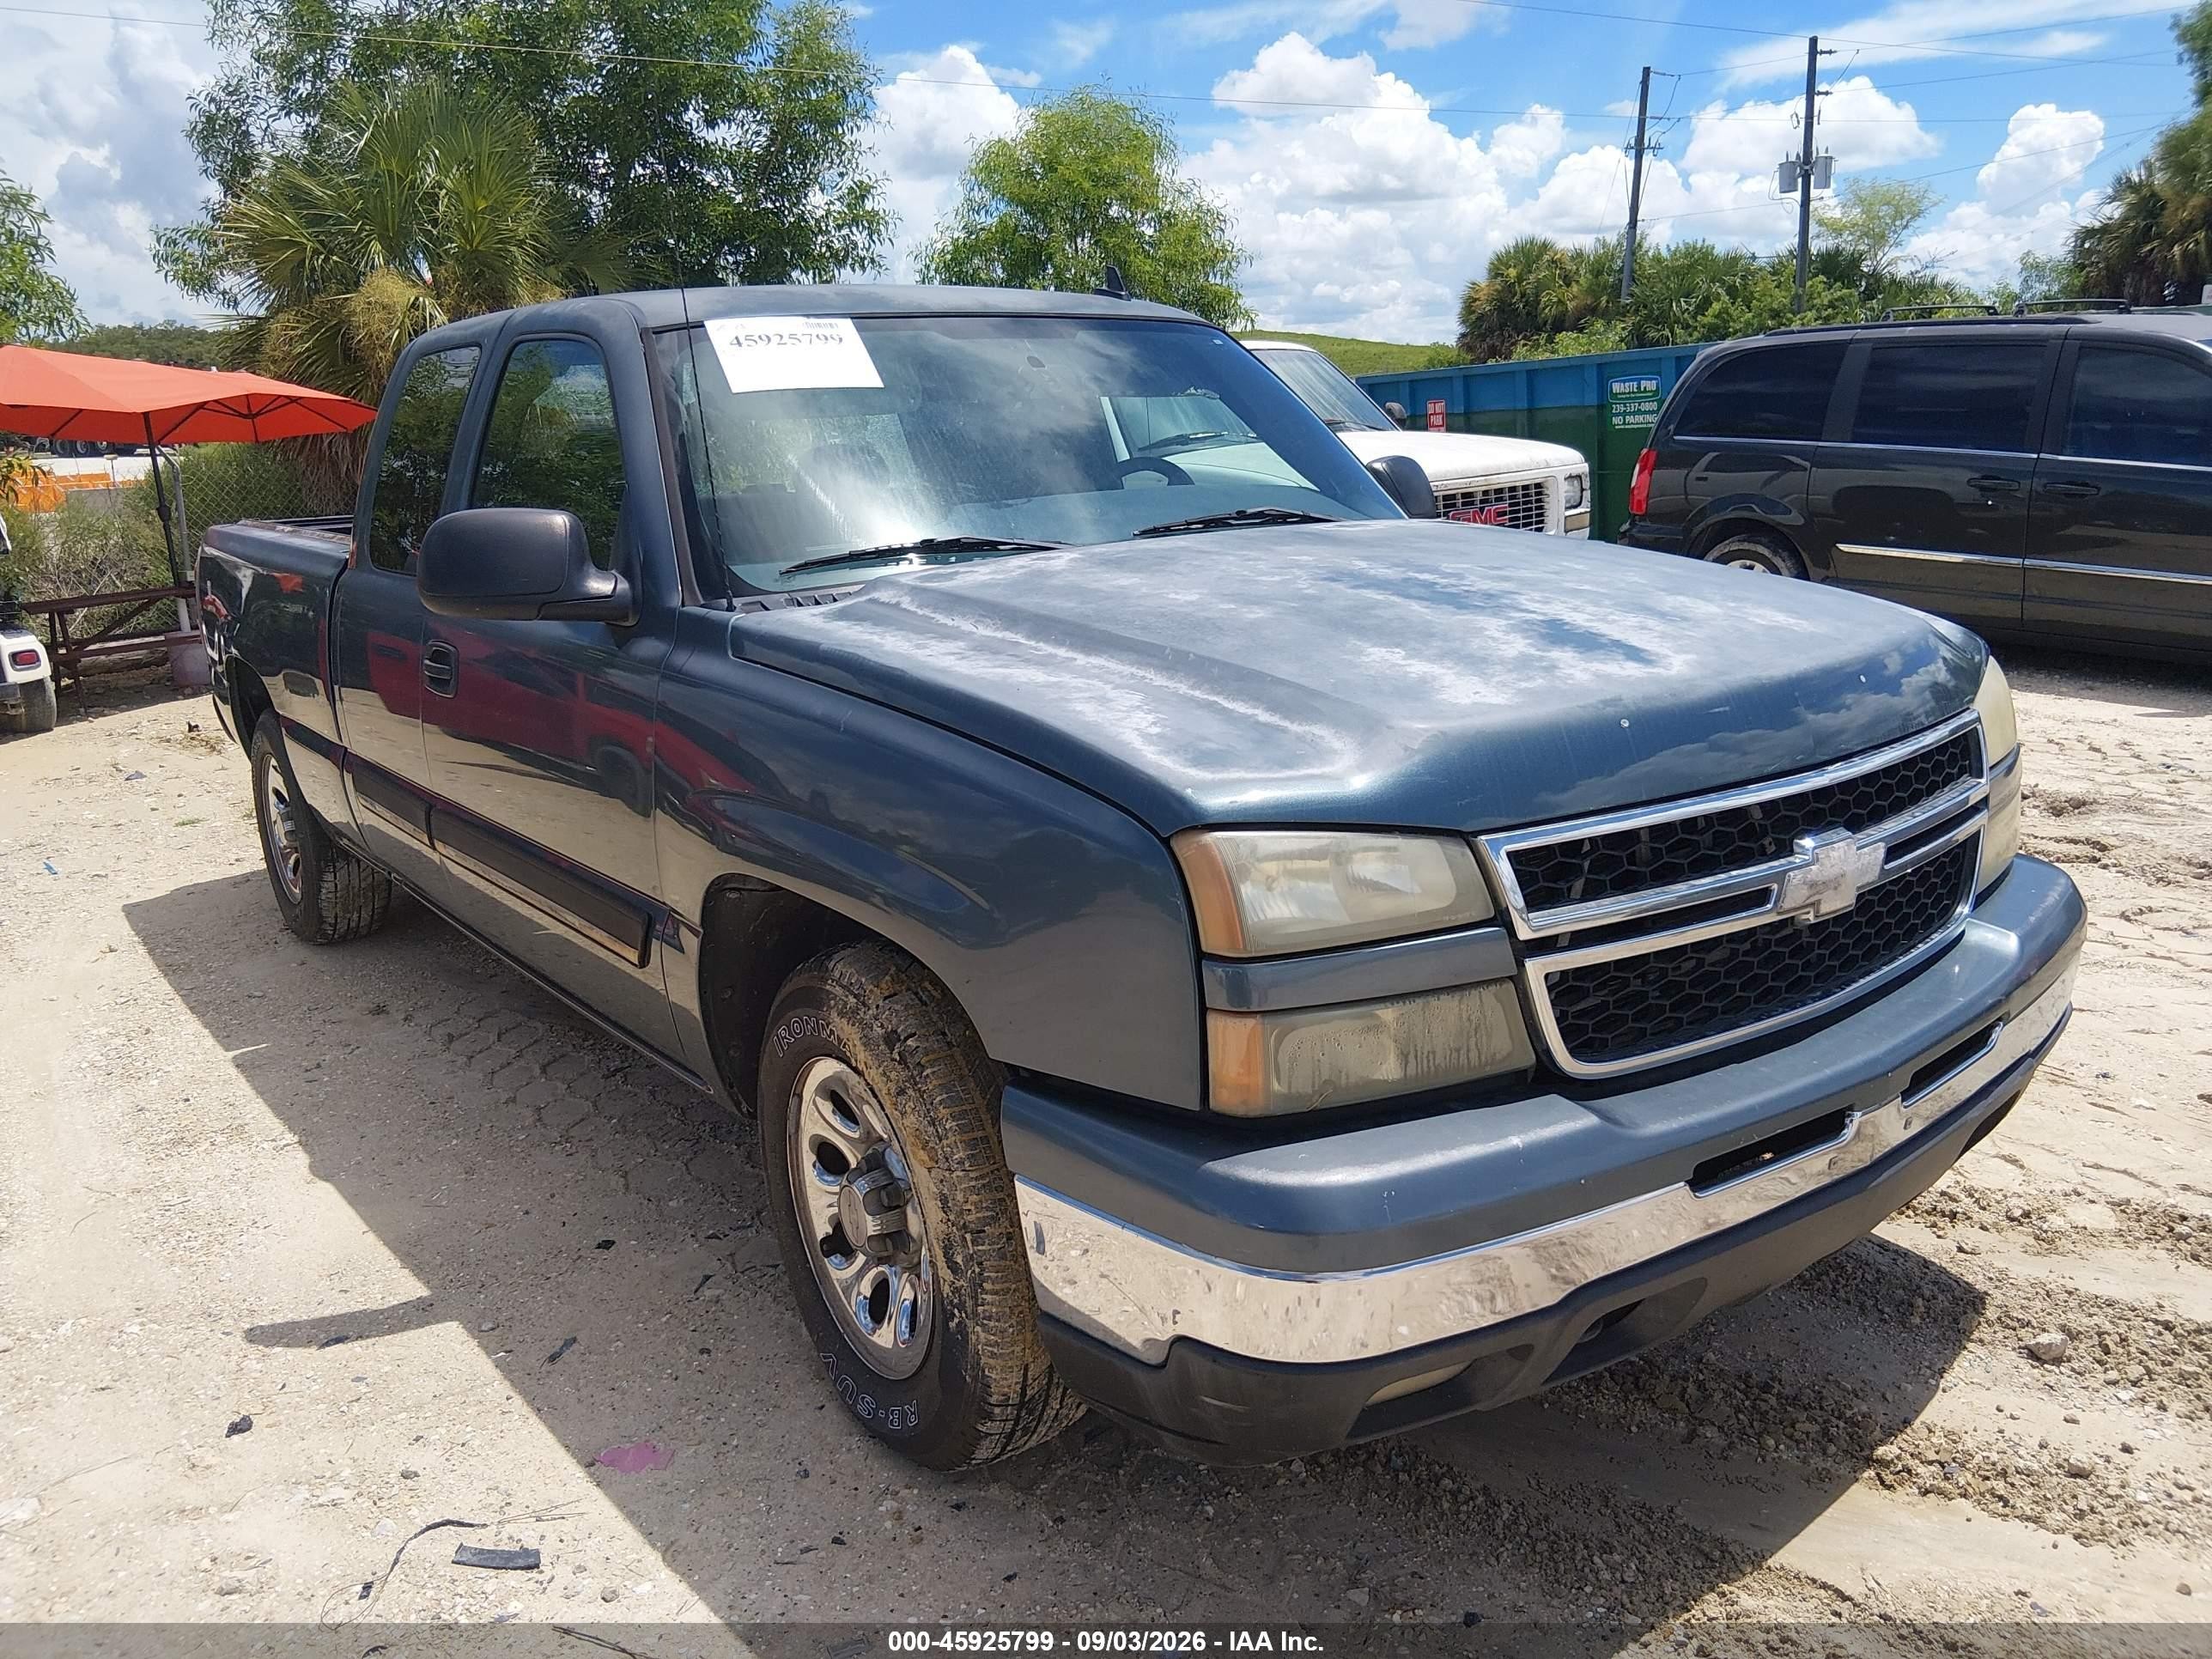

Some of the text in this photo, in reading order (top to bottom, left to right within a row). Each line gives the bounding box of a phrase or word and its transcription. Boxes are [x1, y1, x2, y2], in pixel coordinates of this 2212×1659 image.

[729, 332, 843, 348] 45925799
[1612, 380, 1656, 394] WASTE PRO
[1428, 402, 1444, 414] DO NOT
[1612, 401, 1657, 413] 239-337-0800
[1430, 414, 1443, 427] PARK
[1612, 414, 1657, 426] NO PARKING
[1449, 504, 1509, 526] GMC
[773, 1016, 857, 1066] IRONMA
